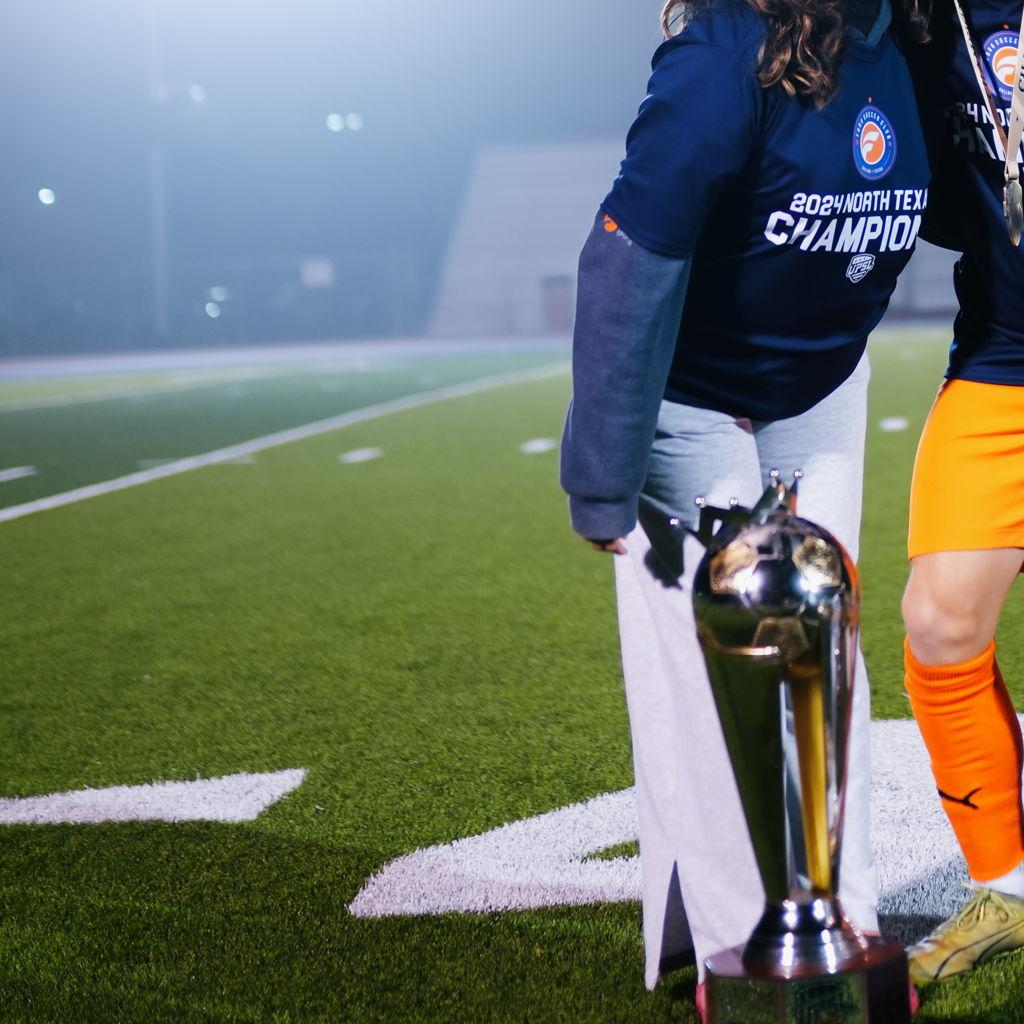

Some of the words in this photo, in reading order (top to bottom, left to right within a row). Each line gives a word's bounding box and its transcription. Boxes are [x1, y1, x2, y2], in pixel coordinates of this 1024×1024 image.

[995, 36, 1018, 46] SOCCE
[789, 192, 845, 216] 2024
[842, 190, 890, 214] NORTH
[894, 188, 928, 211] TEXA
[763, 210, 922, 253] CHAMPIO
[848, 259, 873, 275] UPSL
